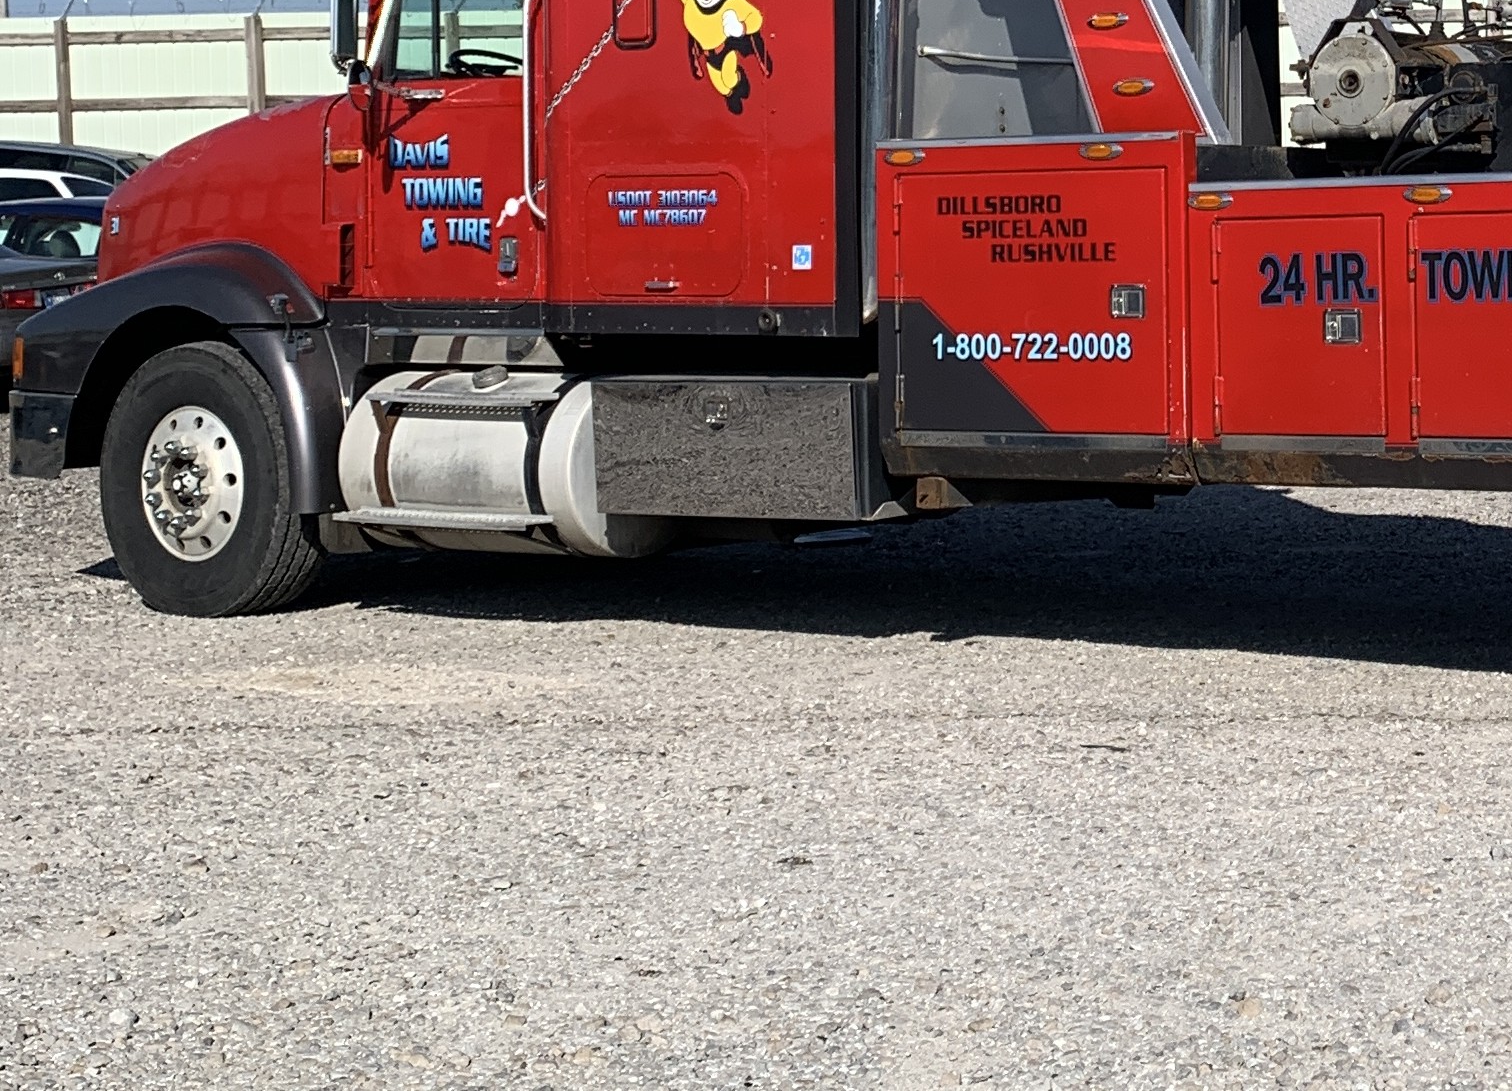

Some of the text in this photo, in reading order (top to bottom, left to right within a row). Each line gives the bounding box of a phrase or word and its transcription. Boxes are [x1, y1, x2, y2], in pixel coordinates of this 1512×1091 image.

[389, 133, 450, 169] DAVIS
[401, 176, 484, 209] TOWING
[608, 189, 718, 207] USDOT 3103064
[937, 194, 1062, 216] DILLSBORO
[618, 208, 639, 226] MC
[961, 218, 1088, 239] SPICELAND
[421, 217, 492, 253] & TIRE
[990, 242, 1117, 263] RUSHVILLE
[1259, 251, 1306, 306] 24
[1315, 251, 1378, 303] HR.
[932, 332, 1132, 361] 1-800-722-0008
